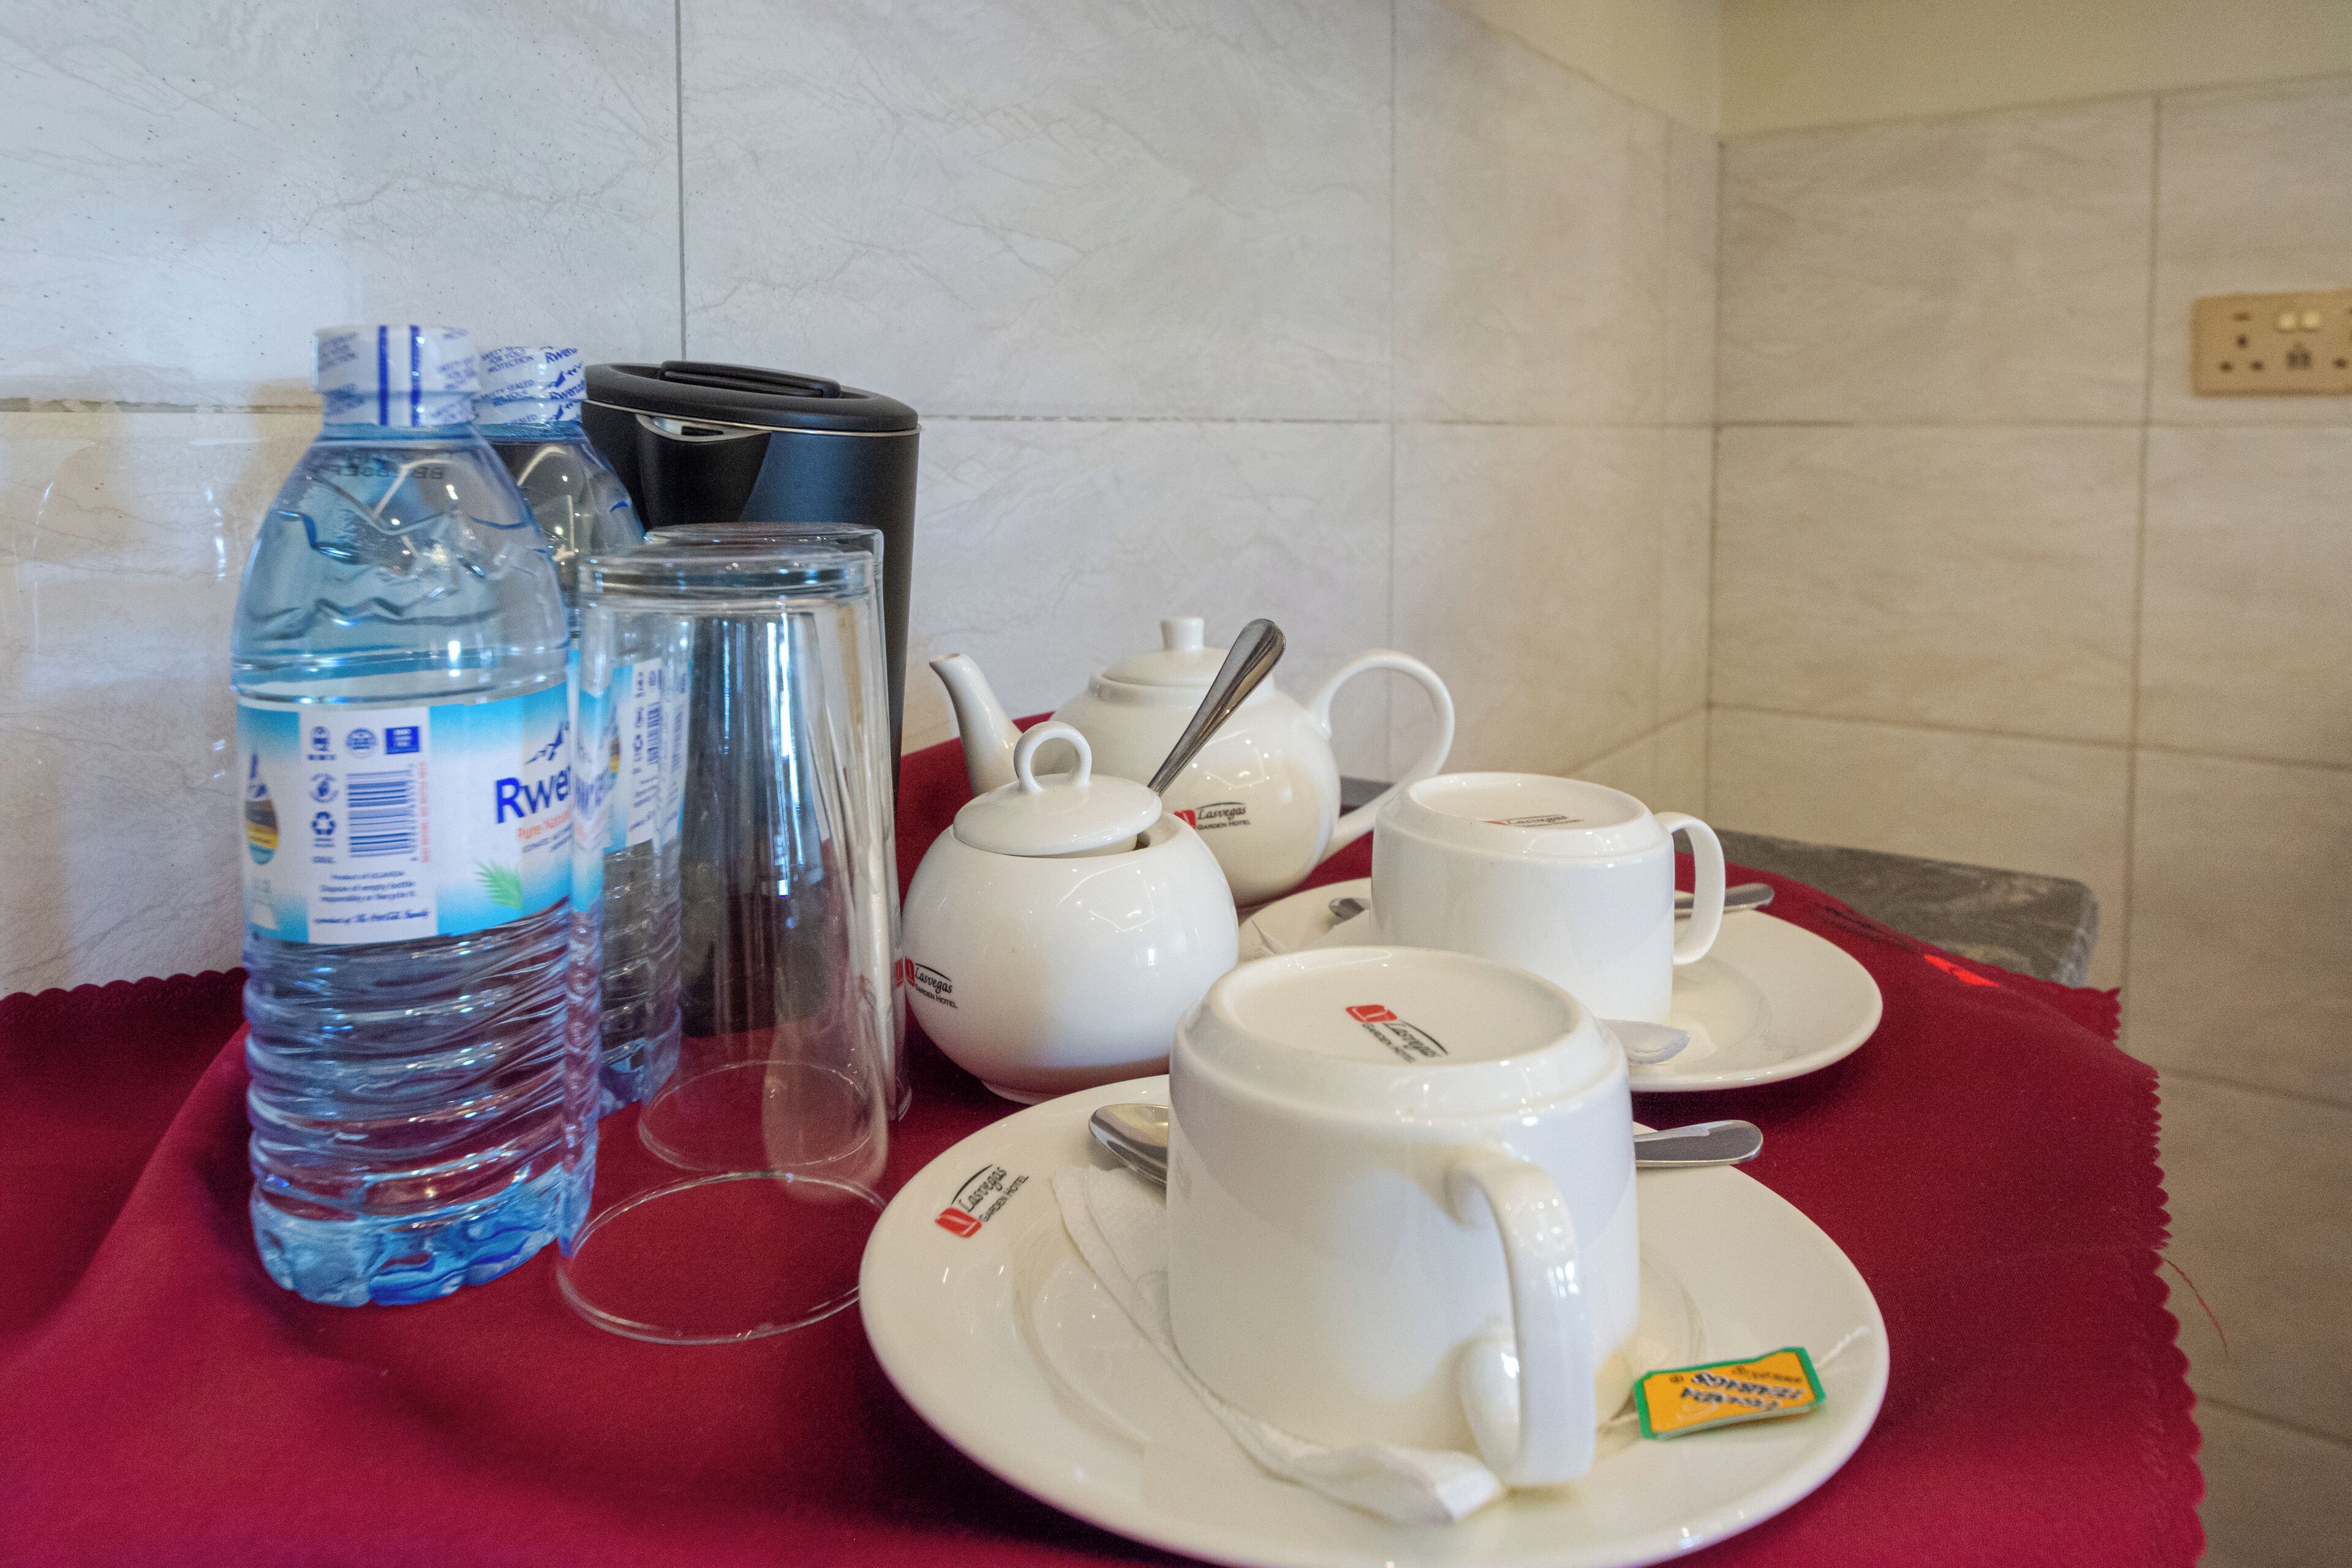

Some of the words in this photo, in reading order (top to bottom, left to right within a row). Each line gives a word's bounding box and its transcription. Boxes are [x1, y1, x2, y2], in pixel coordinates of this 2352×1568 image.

[495, 765, 570, 824] Rwe
[1197, 807, 1246, 820] Lasvegas
[915, 968, 952, 993] Lasvegas
[936, 995, 959, 1008] HOTEL
[959, 1167, 1007, 1213] Lasvegas
